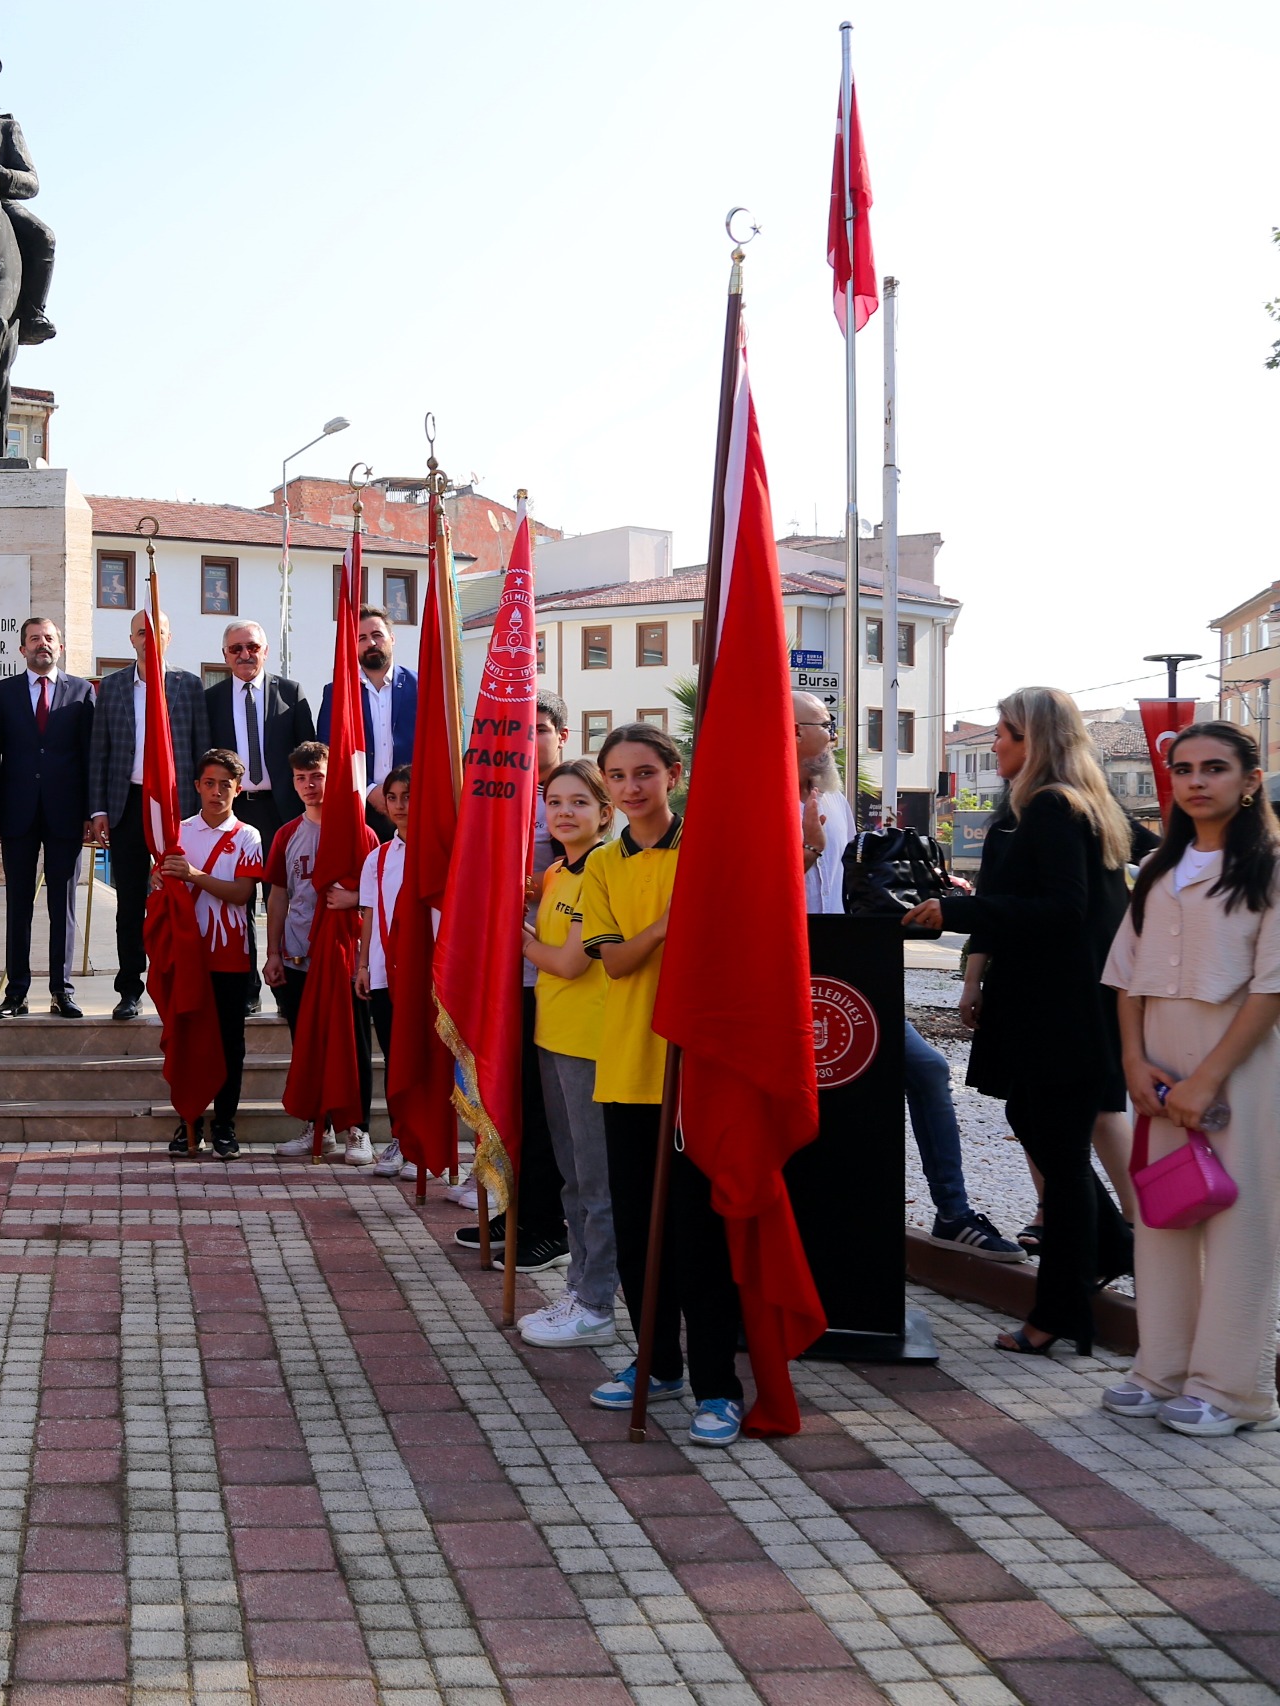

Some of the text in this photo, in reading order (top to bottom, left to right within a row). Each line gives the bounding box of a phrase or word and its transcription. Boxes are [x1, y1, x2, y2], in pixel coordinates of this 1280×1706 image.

[486, 659, 504, 677] TÜRK
[798, 673, 838, 688] Bursa
[472, 714, 522, 737] YYİP
[467, 748, 532, 772] TAOKU
[472, 779, 517, 799] 2020
[810, 986, 867, 1026] ELEDİYESİ
